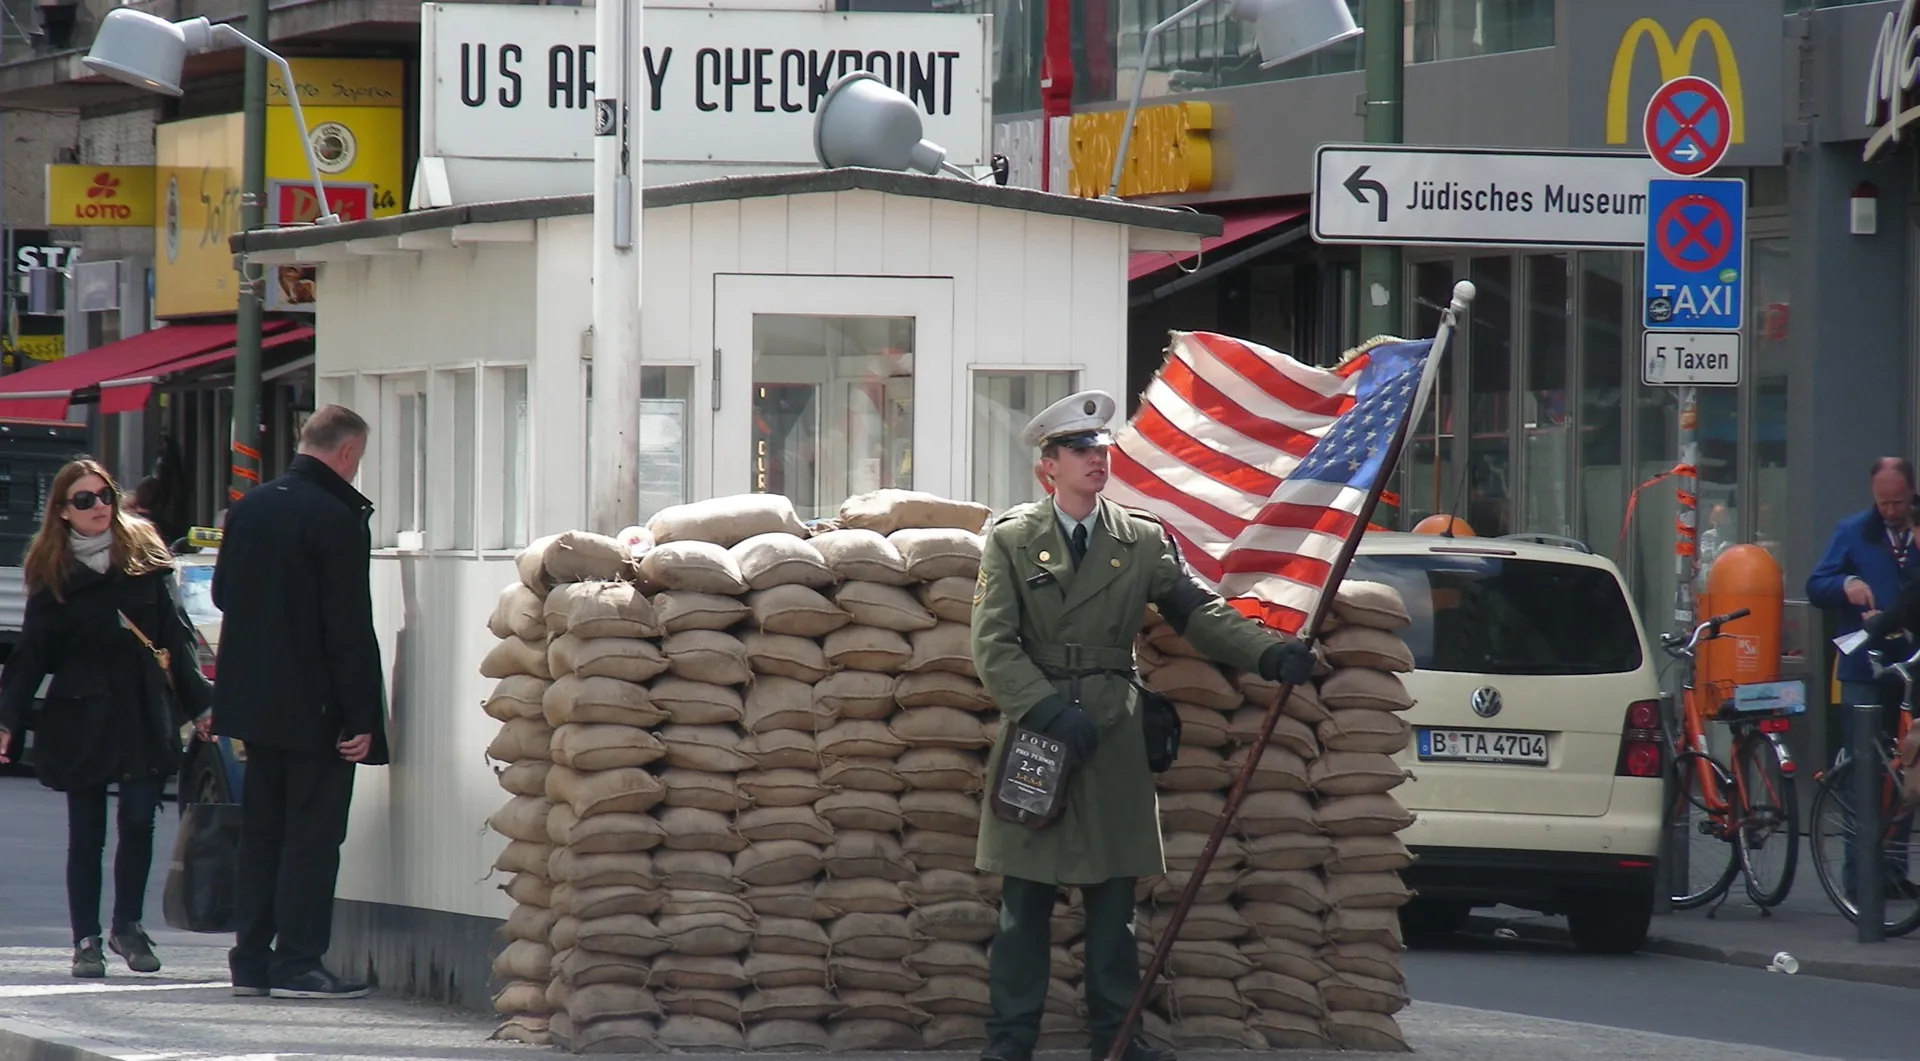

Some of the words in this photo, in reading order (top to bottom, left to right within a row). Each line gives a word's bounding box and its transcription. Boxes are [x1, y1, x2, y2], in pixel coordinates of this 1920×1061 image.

[548, 45, 673, 111] ARY
[75, 203, 131, 220] LOTTO
[1406, 181, 1534, 213] Jüdisches
[1544, 184, 1646, 215] Museum
[1654, 284, 1732, 316] TAXI
[1674, 346, 1729, 370] Taxen
[1433, 732, 1446, 753] B
[1461, 734, 1488, 755] TA
[1493, 735, 1544, 757] 4704
